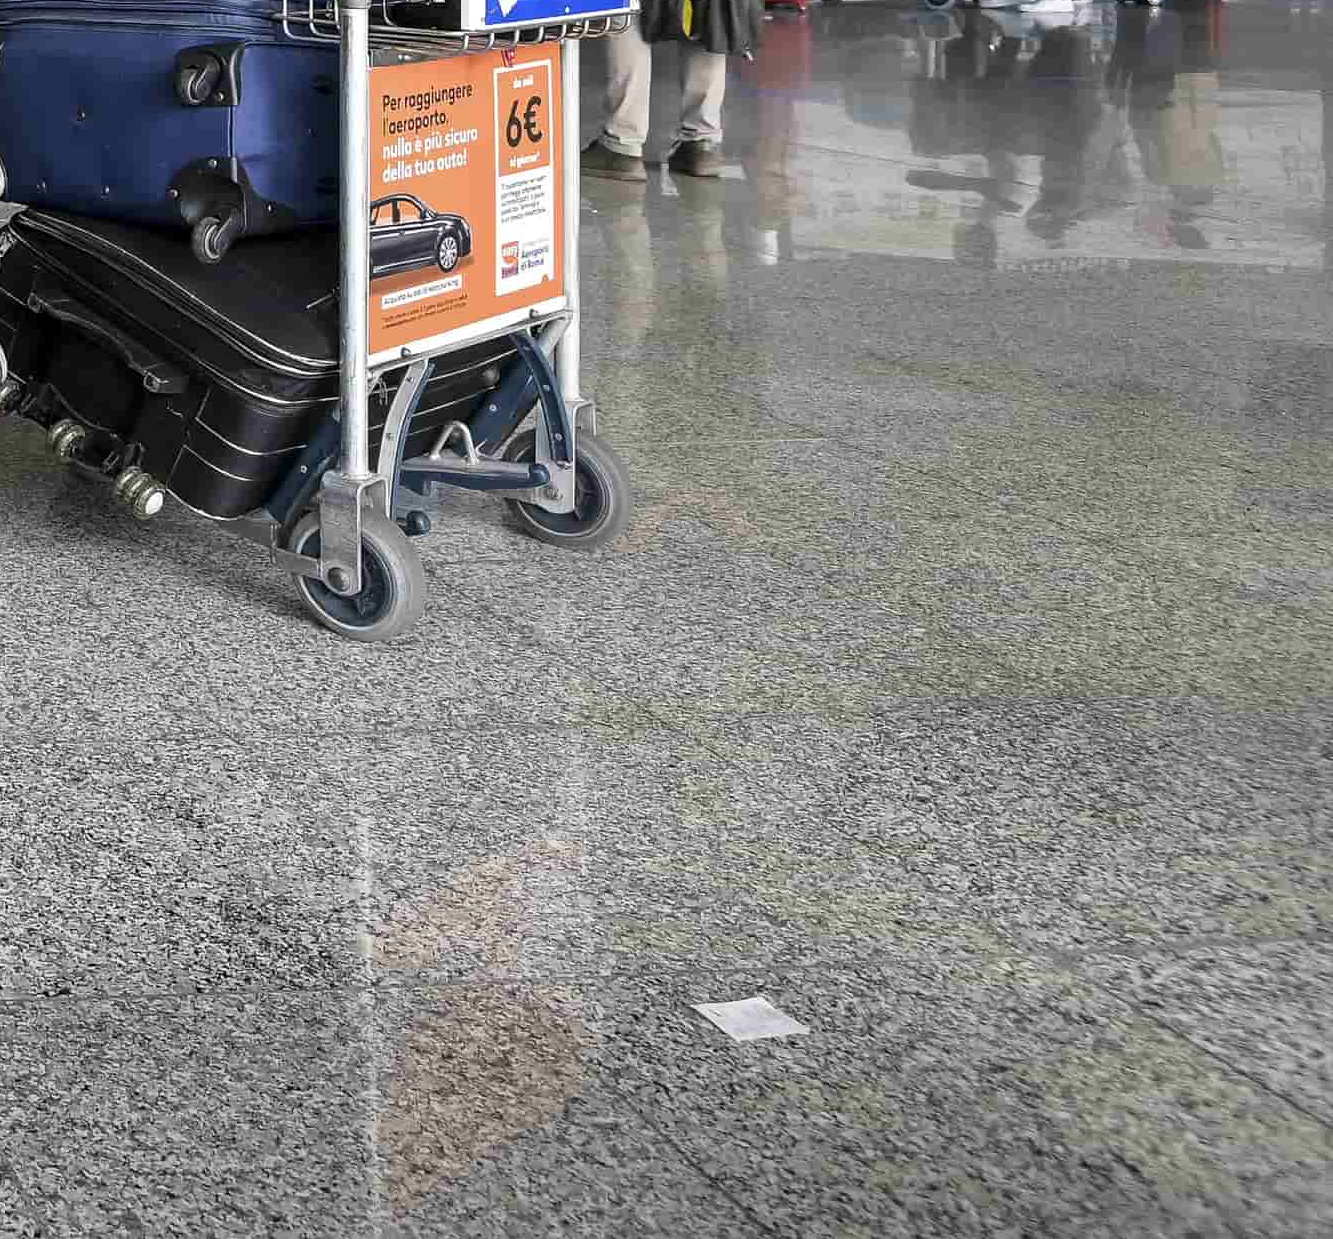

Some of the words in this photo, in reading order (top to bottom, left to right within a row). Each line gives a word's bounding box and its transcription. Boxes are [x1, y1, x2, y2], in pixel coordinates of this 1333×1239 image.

[382, 95, 402, 112] Per
[404, 84, 473, 111] raggiungere
[506, 96, 543, 147] 6€
[382, 136, 412, 160] nulla
[414, 137, 423, 153] è
[424, 131, 443, 157] più
[444, 127, 478, 147] sicuro
[382, 160, 412, 183] della
[414, 159, 434, 176] tua
[436, 148, 468, 171] auto!
